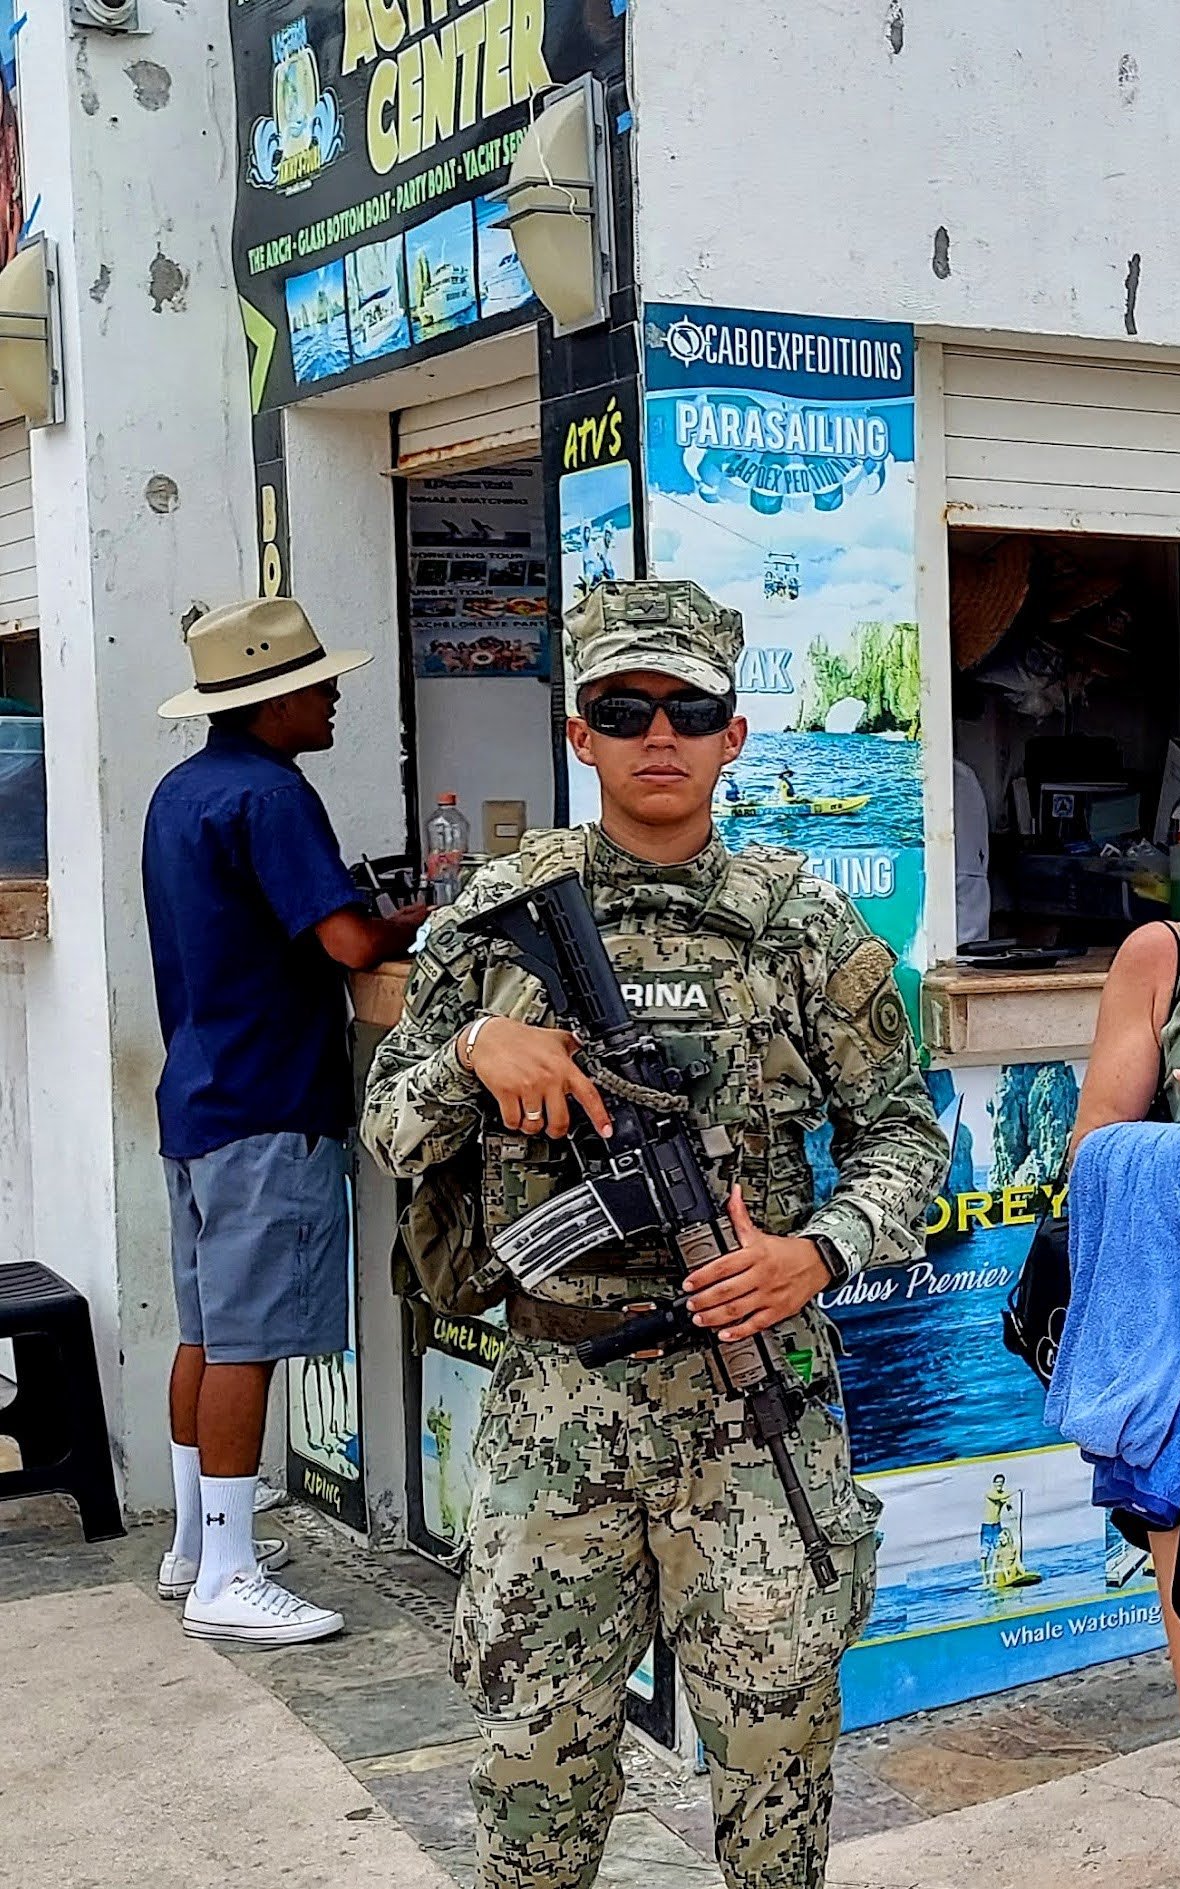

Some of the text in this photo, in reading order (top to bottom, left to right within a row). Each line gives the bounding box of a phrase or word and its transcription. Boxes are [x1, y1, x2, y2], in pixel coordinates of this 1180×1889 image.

[366, 0, 553, 175] CENTER
[248, 245, 265, 275] THE
[266, 235, 292, 267] ARCH
[298, 221, 326, 256] GLASS
[327, 203, 365, 245] BOTTOM
[366, 191, 391, 228] BOAT
[396, 172, 427, 214] PARTY
[428, 158, 456, 199] BOAT
[463, 138, 501, 181] YACHT
[704, 324, 902, 380] CABOEXPEDITIONS
[677, 401, 888, 459] PARASAILING
[620, 983, 709, 1008] RINA
[905, 1261, 1015, 1299] Premier
[1000, 1604, 1163, 1649] Whale Watching
